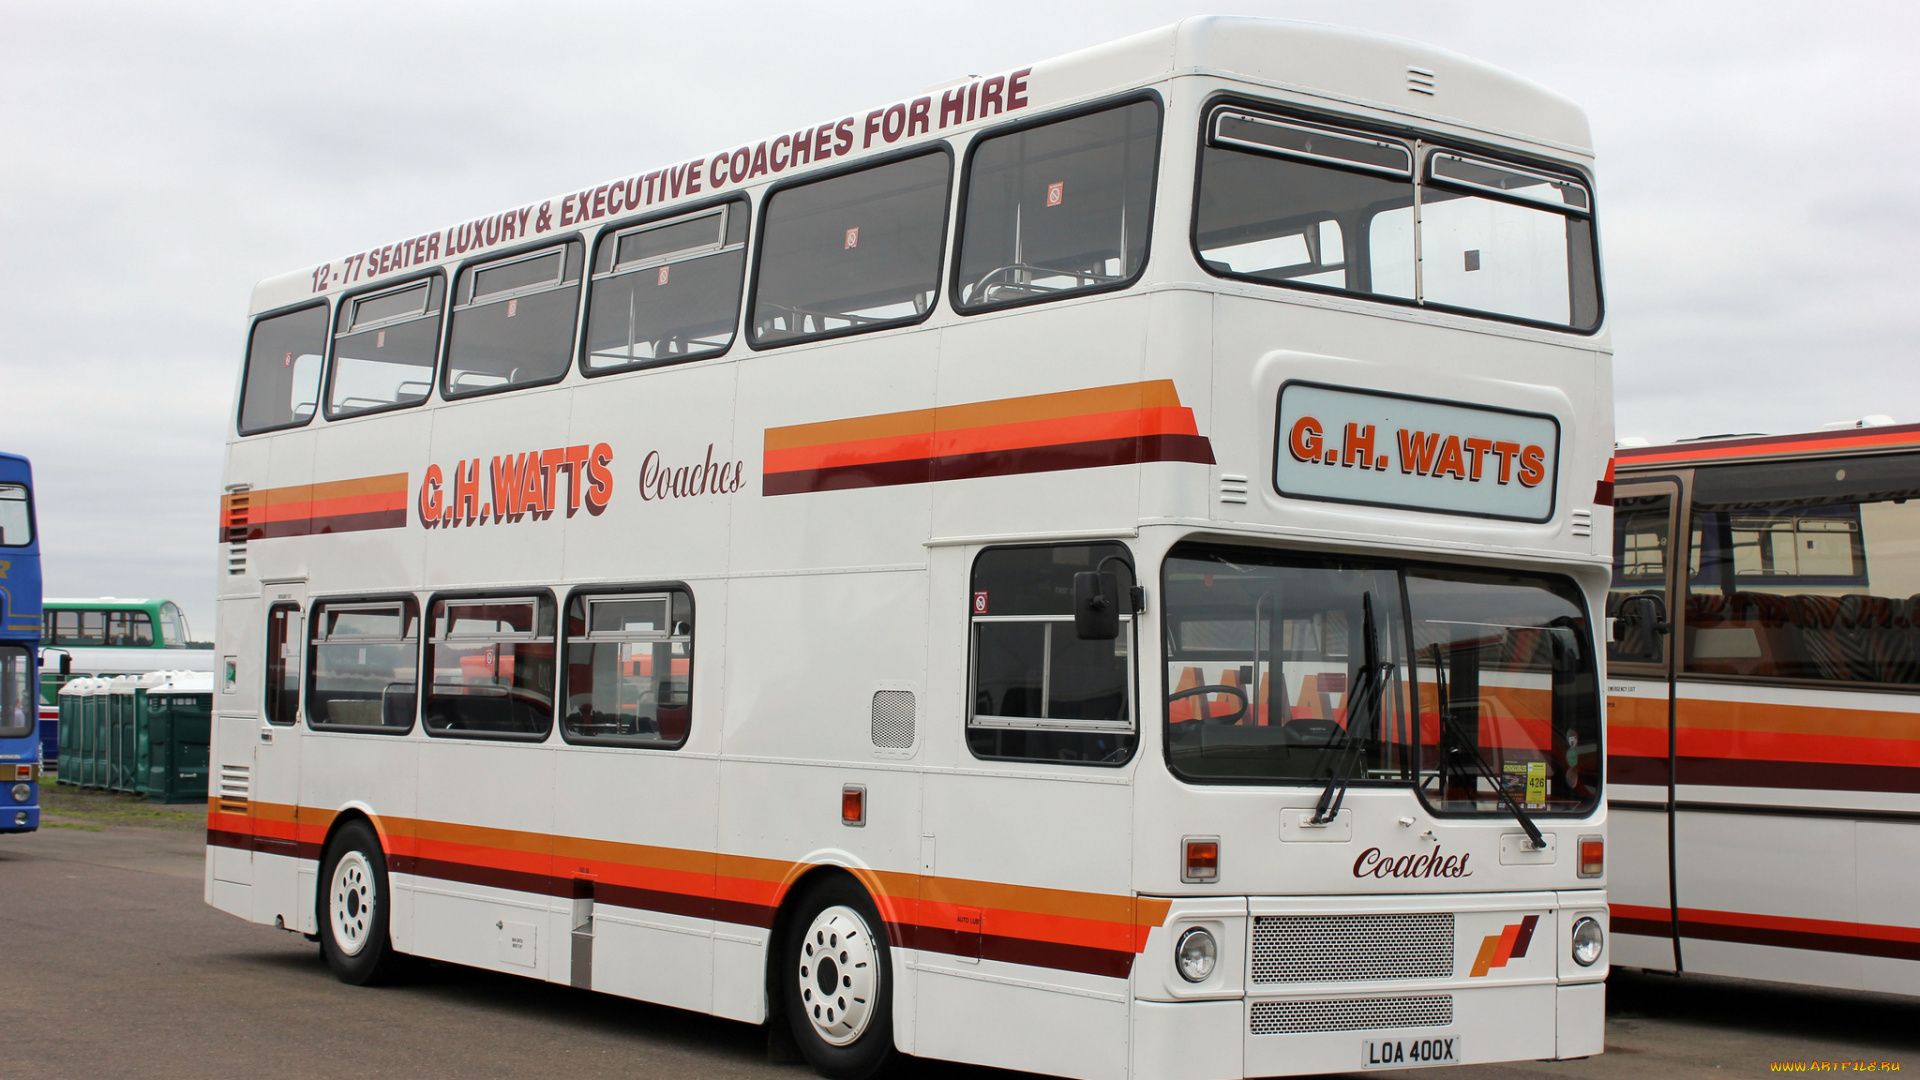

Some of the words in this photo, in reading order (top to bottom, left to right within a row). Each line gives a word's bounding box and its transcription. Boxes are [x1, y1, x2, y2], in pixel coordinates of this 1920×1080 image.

[312, 261, 330, 293] 12
[343, 253, 366, 284] 77
[366, 231, 441, 277] SEATER
[445, 204, 535, 257] LUXURY
[535, 200, 552, 234] &
[559, 158, 705, 227] EXECUTIVE
[709, 116, 855, 189] COACHES
[862, 96, 932, 149] FOR
[938, 66, 1034, 130] HIRE
[639, 443, 747, 501] Coaches
[1288, 416, 1390, 472] G.H.
[1396, 428, 1546, 489] WATTS
[1529, 778, 1545, 789] 426
[1352, 844, 1473, 879] Coaches
[1369, 1041, 1404, 1064] LOA
[1409, 1038, 1454, 1062] 400X
